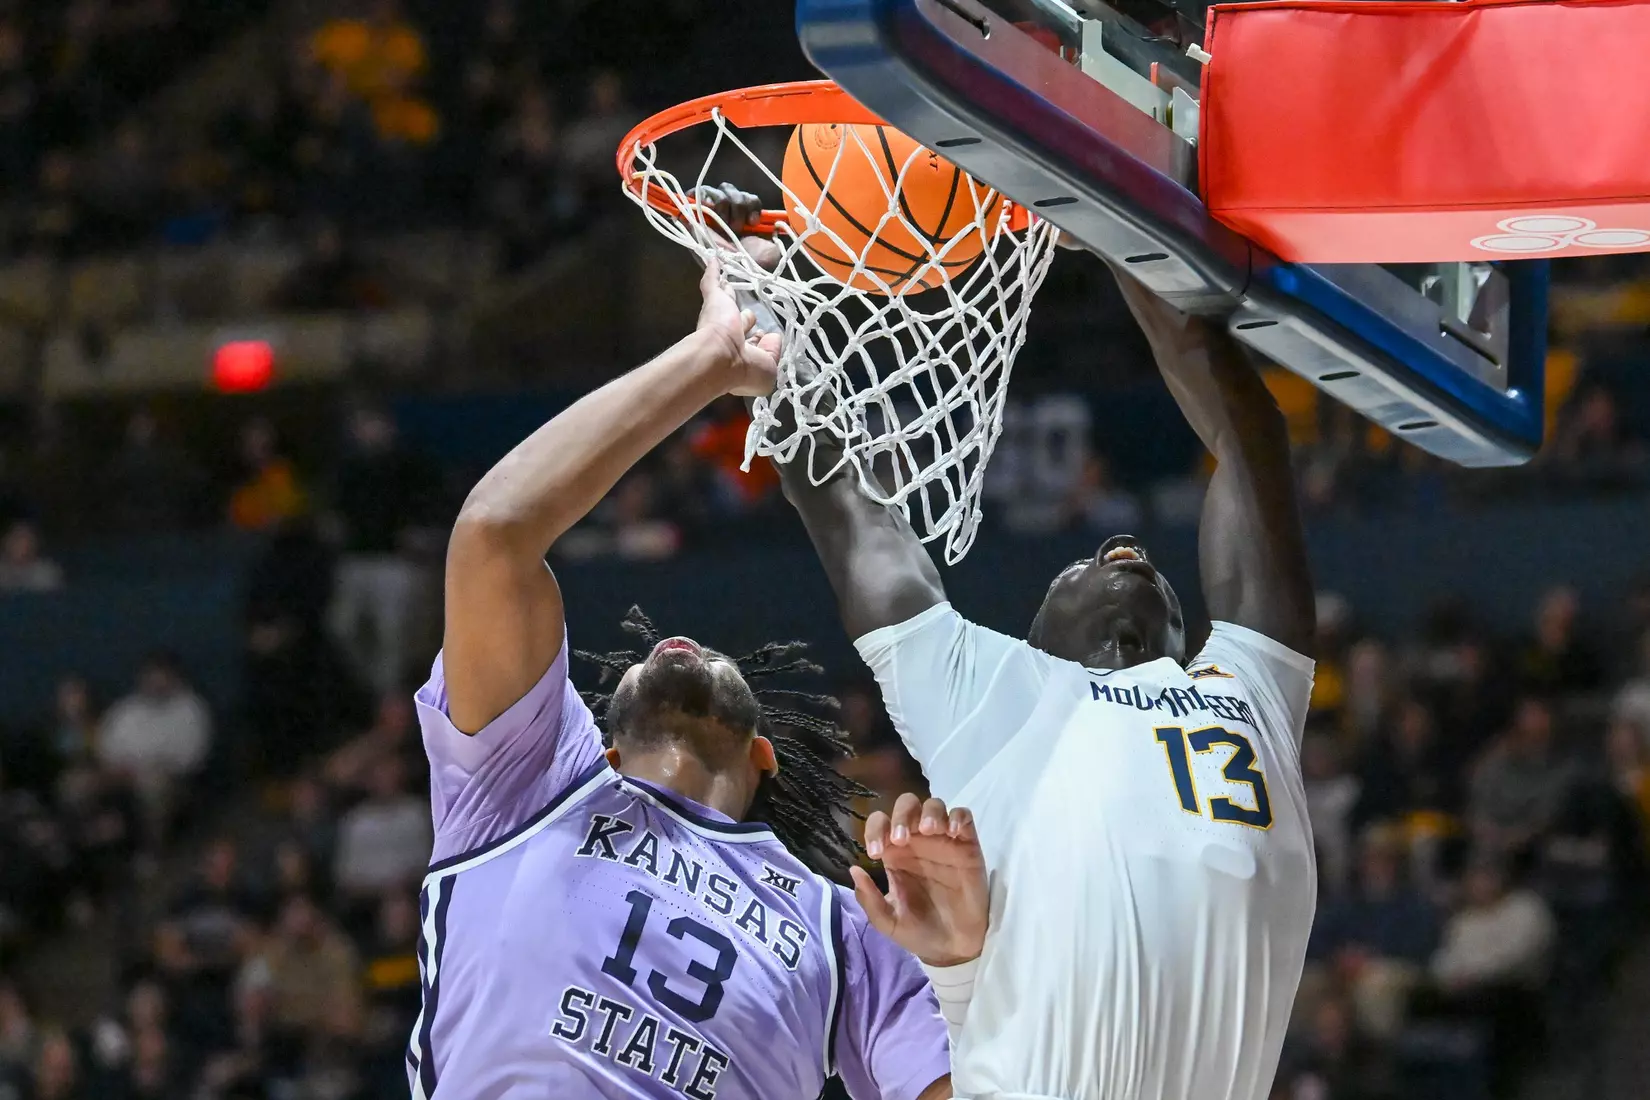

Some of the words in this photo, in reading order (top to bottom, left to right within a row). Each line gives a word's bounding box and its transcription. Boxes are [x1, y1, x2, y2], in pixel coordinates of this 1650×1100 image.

[1152, 726, 1275, 830] 13
[574, 813, 808, 972] KANSAS
[761, 861, 804, 898] XII
[601, 890, 738, 1023] 13
[550, 985, 731, 1100] STATE
